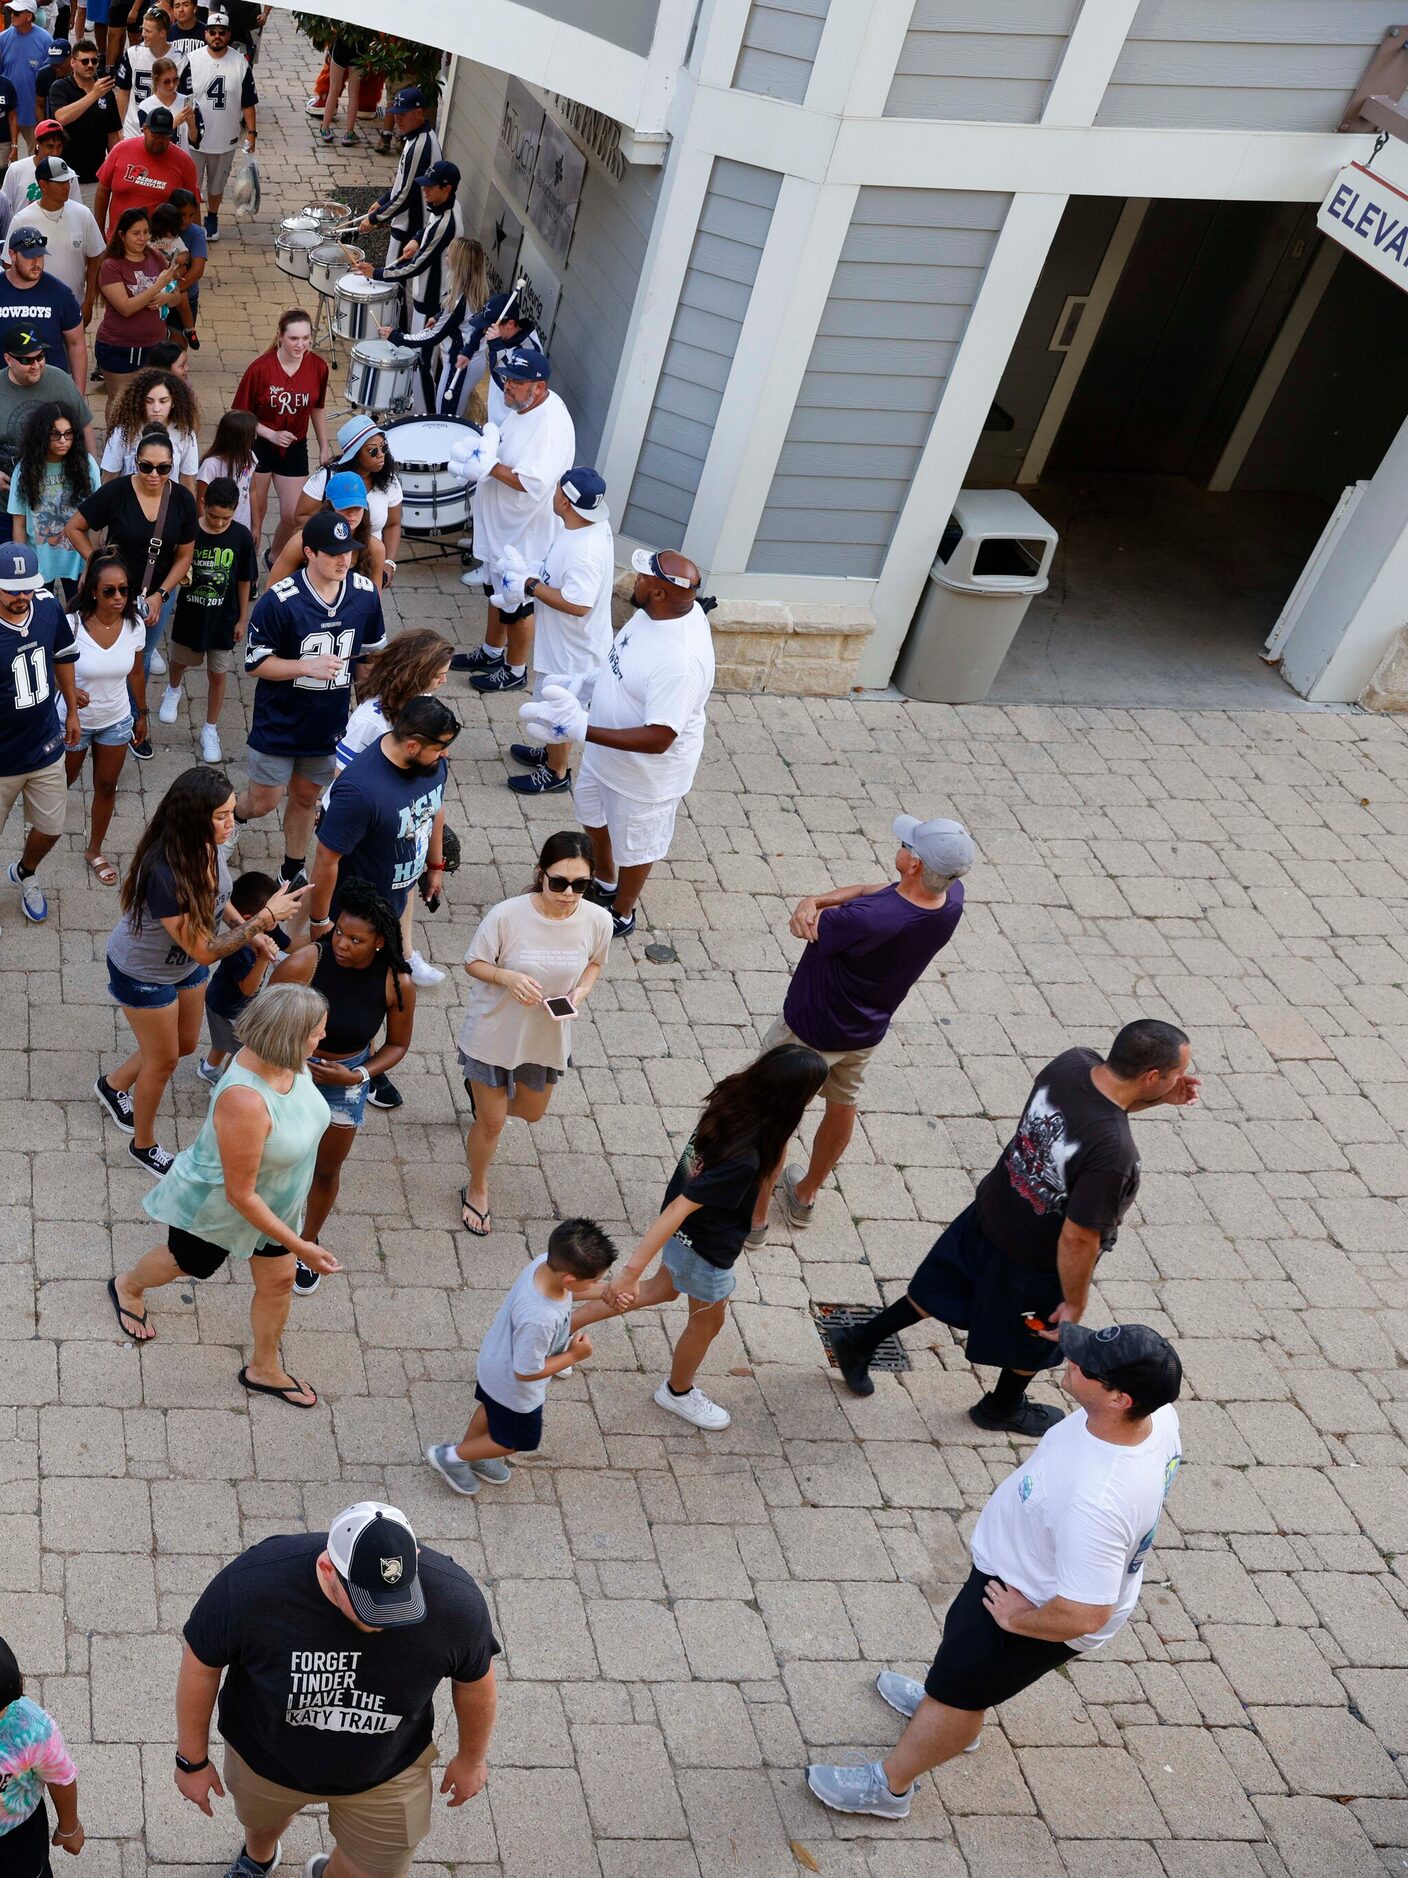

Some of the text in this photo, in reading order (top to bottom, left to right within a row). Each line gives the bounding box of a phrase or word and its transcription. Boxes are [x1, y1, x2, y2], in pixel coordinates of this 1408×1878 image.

[206, 75, 227, 110] 4
[1326, 183, 1408, 269] ELEVA
[270, 391, 310, 415] CREW
[13, 557, 27, 575] D
[293, 628, 356, 691] 21
[11, 646, 50, 710] 11
[291, 1651, 362, 1672] FORGET
[290, 1671, 356, 1693] TINDER
[287, 1689, 386, 1712] I HAVE THE
[289, 1709, 333, 1726] KATY
